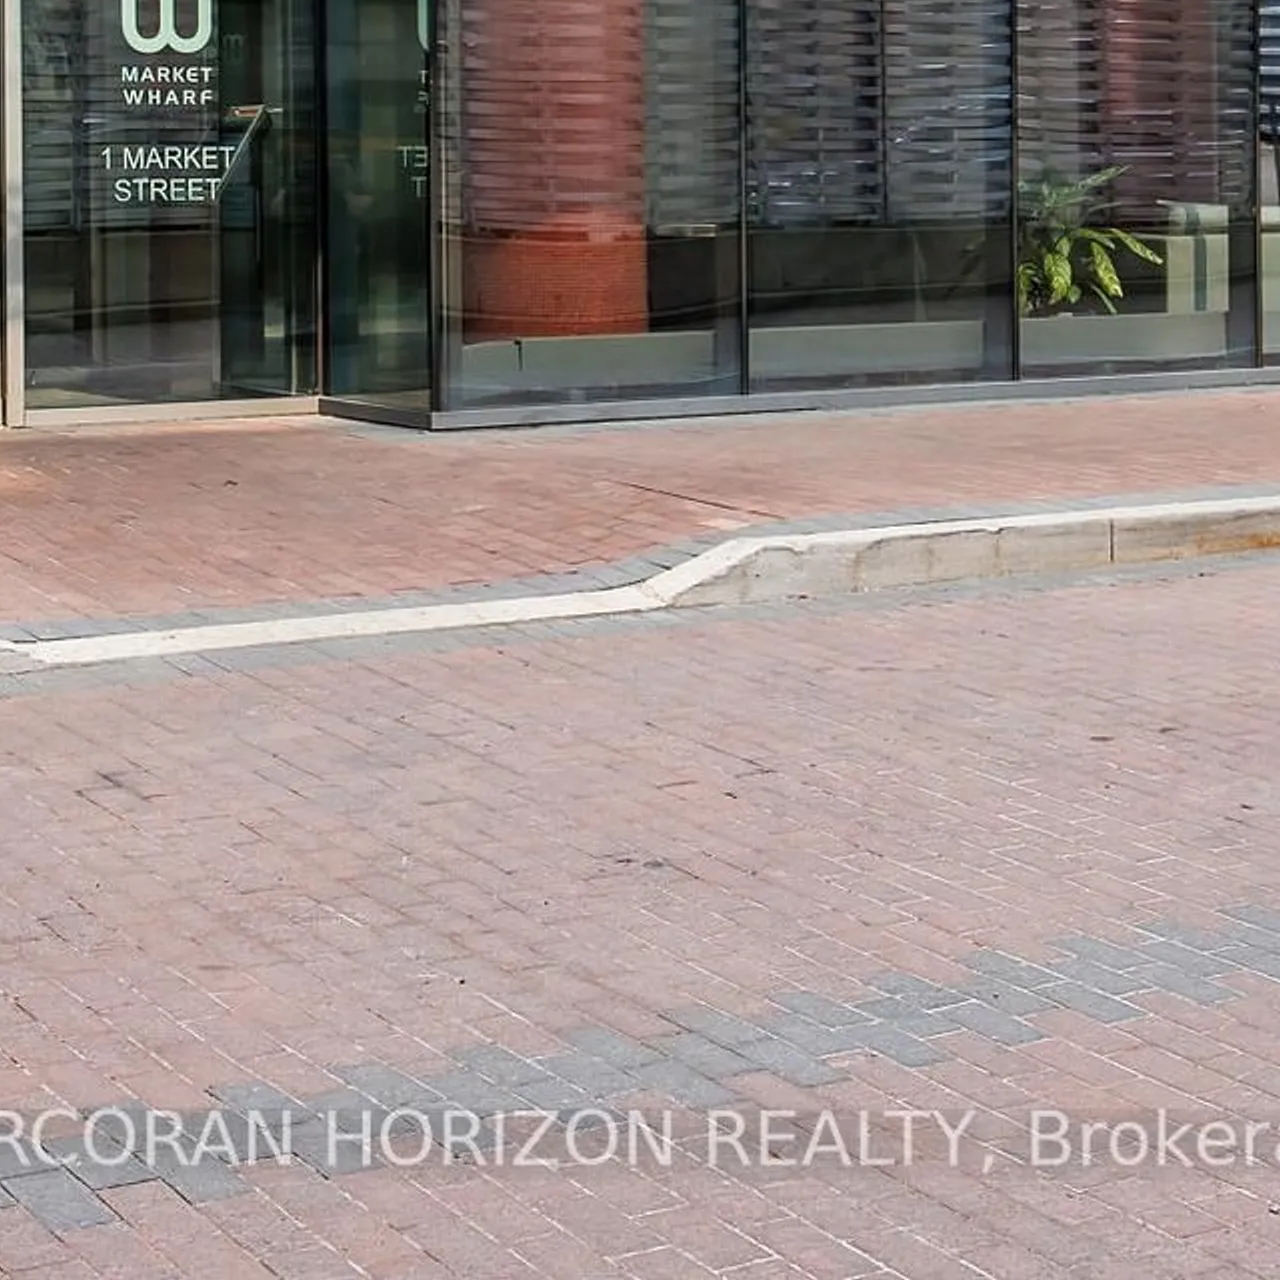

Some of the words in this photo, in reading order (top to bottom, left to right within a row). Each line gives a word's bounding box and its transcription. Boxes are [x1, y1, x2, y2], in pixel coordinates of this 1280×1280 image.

[121, 66, 213, 83] MARKET
[123, 89, 213, 106] WHARF
[101, 147, 111, 170] 1
[124, 147, 236, 170] MARKET
[114, 178, 222, 202] STREET
